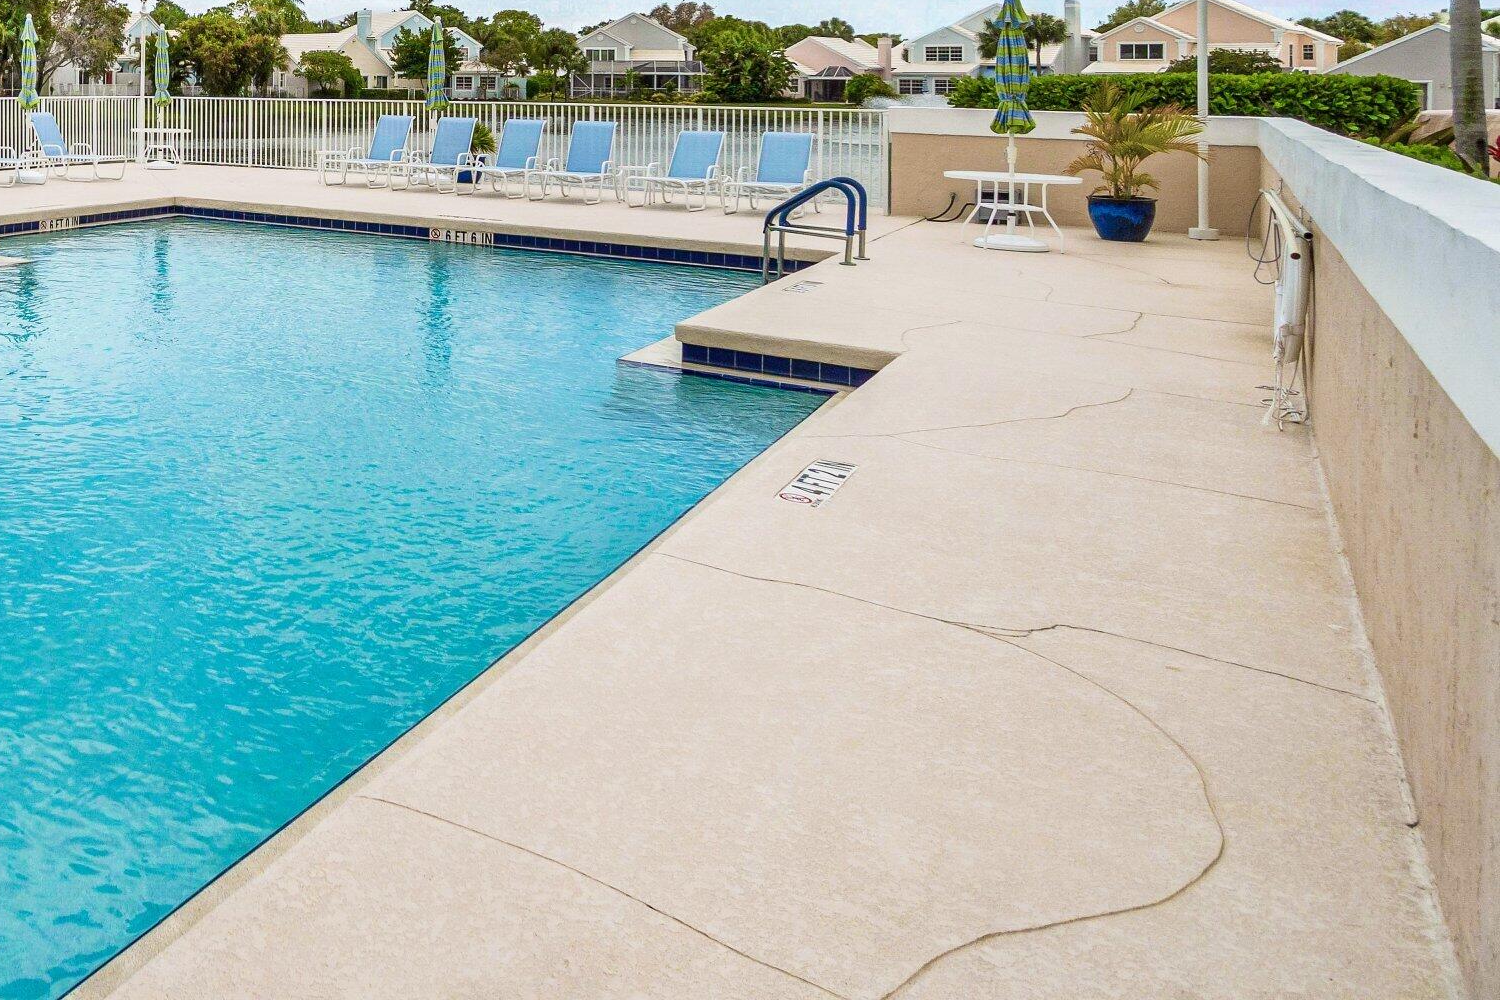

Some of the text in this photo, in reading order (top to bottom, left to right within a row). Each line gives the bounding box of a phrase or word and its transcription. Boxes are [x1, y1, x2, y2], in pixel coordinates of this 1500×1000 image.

[55, 218, 64, 228] FT
[71, 216, 79, 226] IN
[445, 229, 492, 244] 6 FT 6 IN
[791, 461, 856, 496] 4 FT 2 IN
